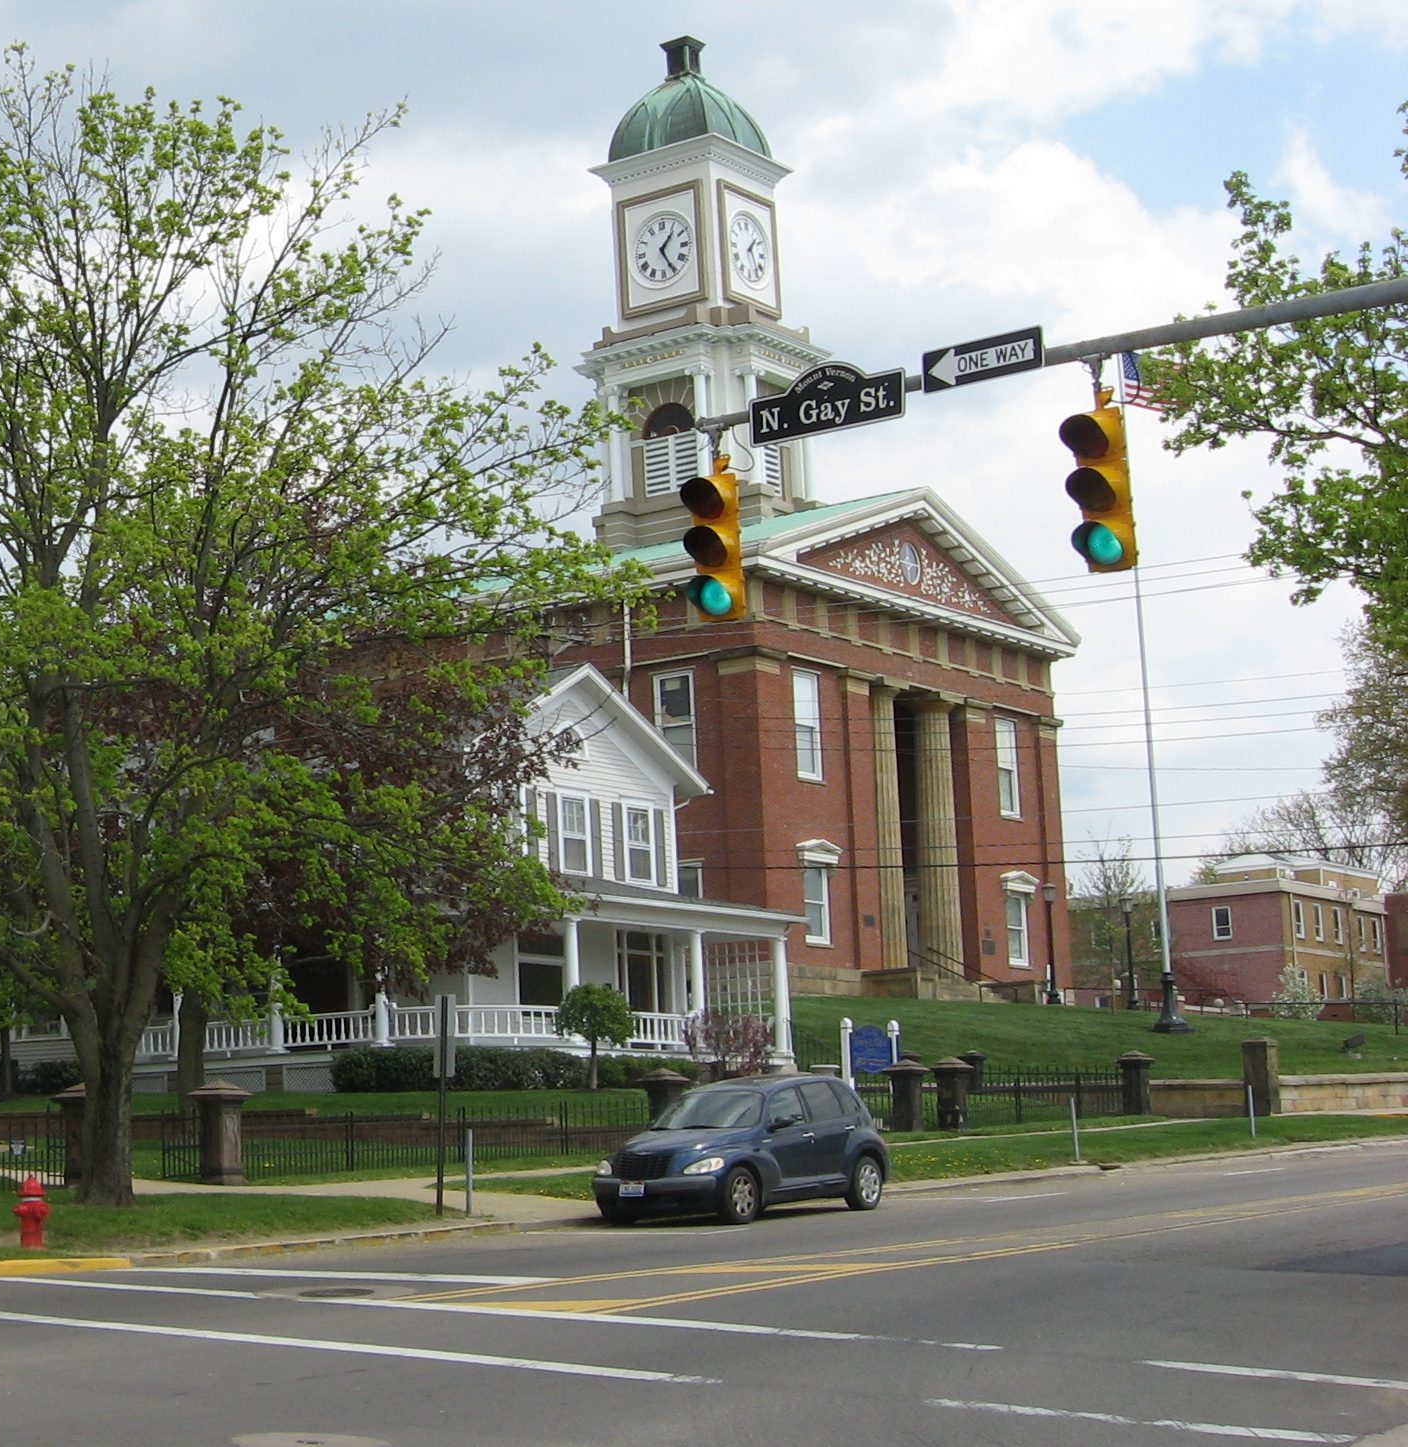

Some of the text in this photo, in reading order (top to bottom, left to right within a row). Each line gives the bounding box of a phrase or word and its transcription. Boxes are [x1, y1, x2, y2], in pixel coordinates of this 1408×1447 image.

[957, 347, 1029, 373] ONE WAY
[794, 367, 857, 394] Mount Vernon
[759, 387, 895, 434] N. Gay St.
